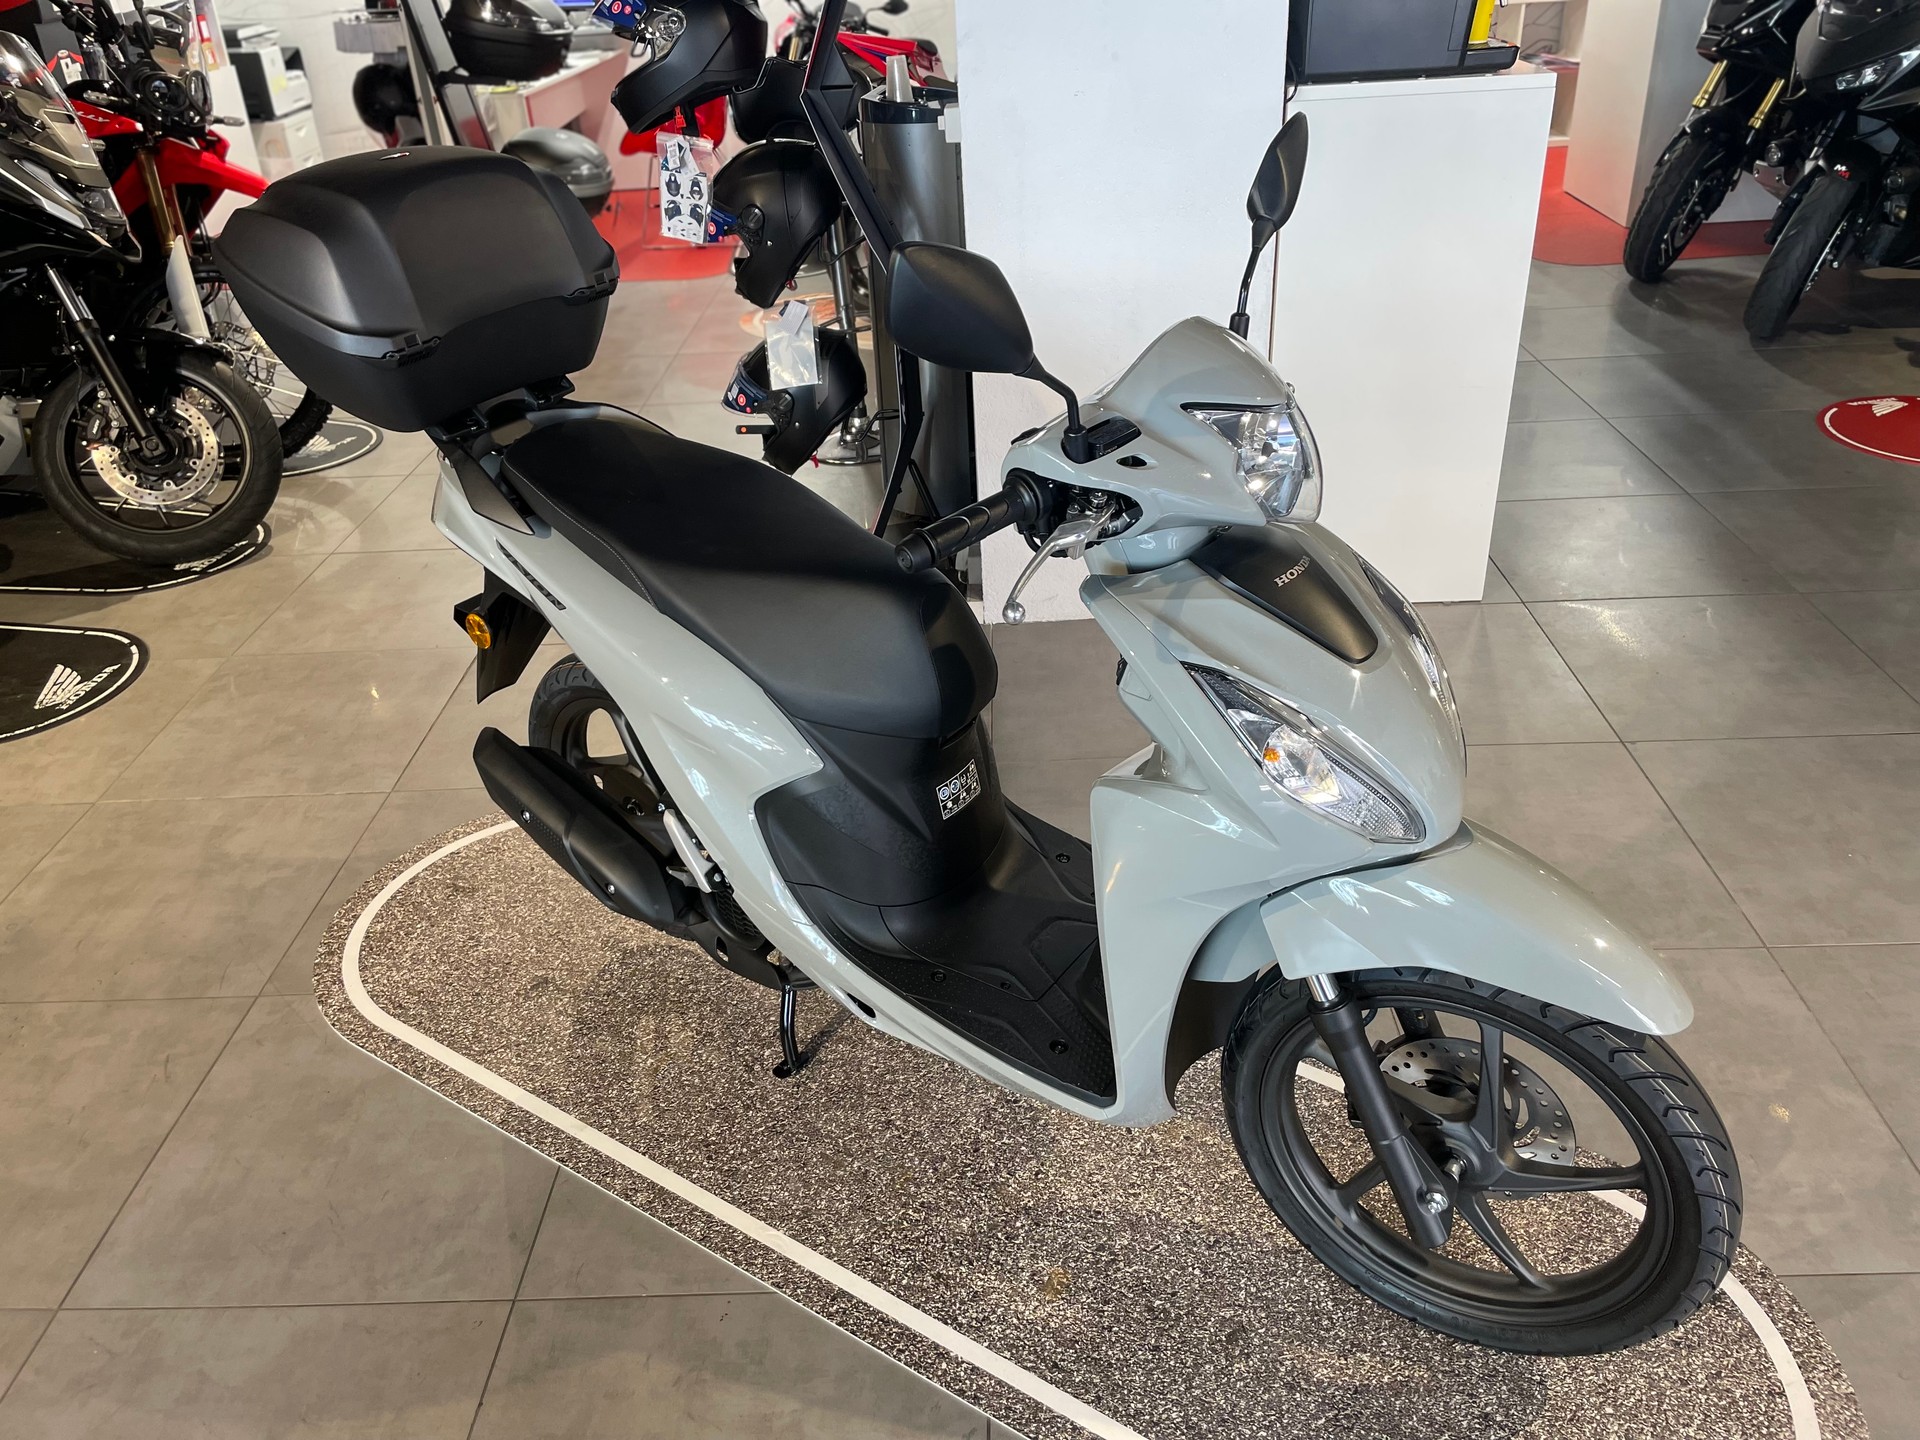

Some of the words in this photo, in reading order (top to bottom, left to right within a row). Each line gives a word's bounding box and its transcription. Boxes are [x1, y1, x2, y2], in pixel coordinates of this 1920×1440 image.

[496, 539, 567, 611] VISION
[1273, 555, 1311, 587] HONDA
[55, 663, 121, 710] HONDA
